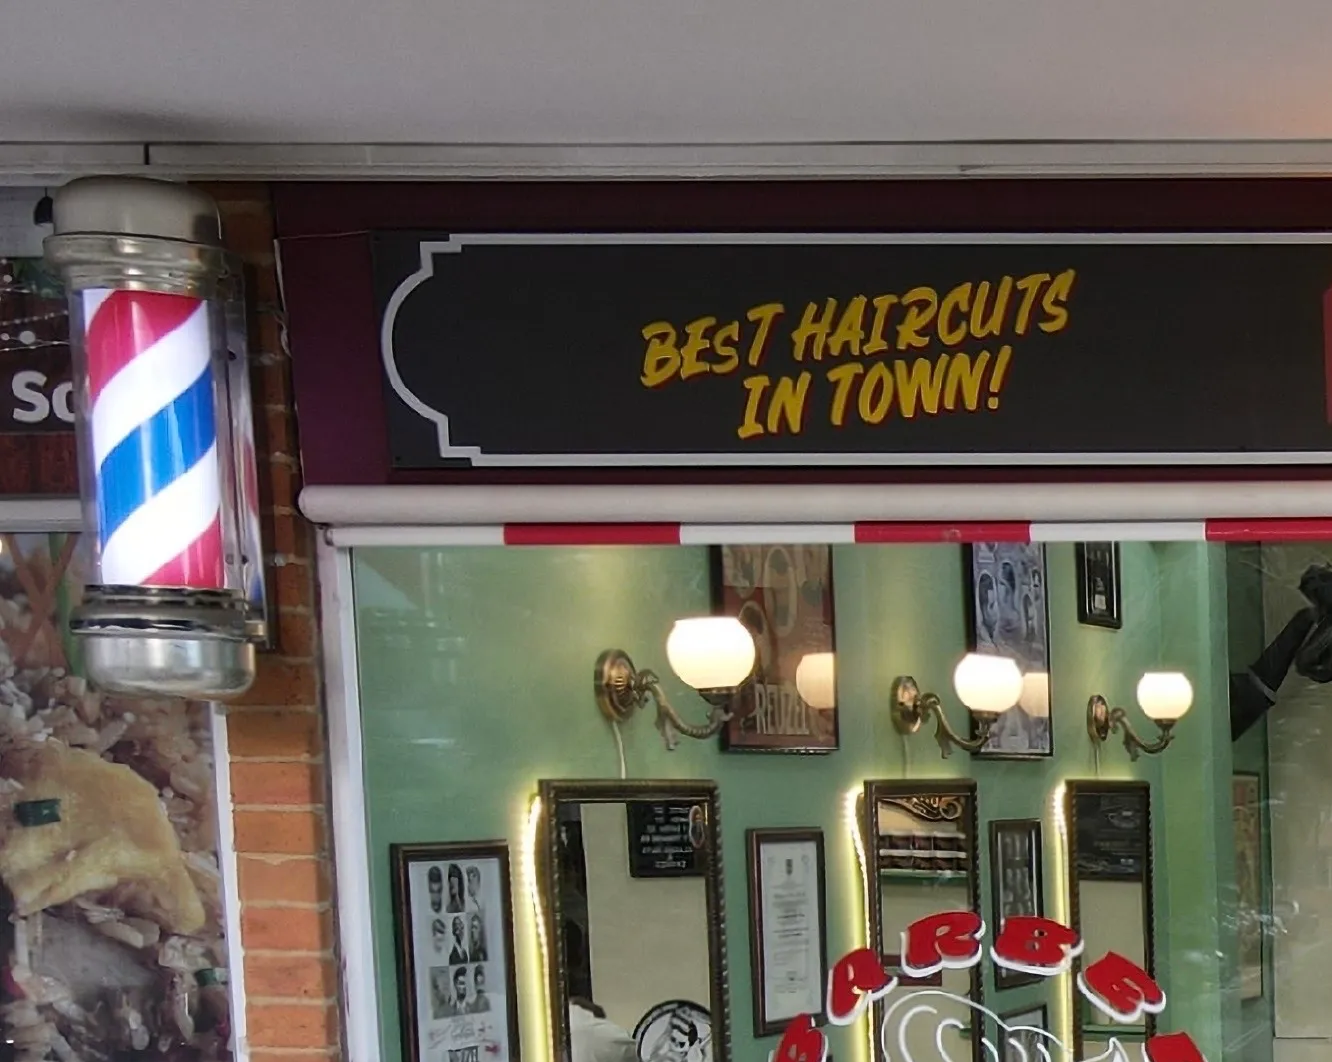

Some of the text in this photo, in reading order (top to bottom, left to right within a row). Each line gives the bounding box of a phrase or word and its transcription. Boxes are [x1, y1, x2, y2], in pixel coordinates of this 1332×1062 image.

[640, 268, 1077, 389] BEST HAIRCUTS
[737, 345, 1014, 440] IN TOWN!
